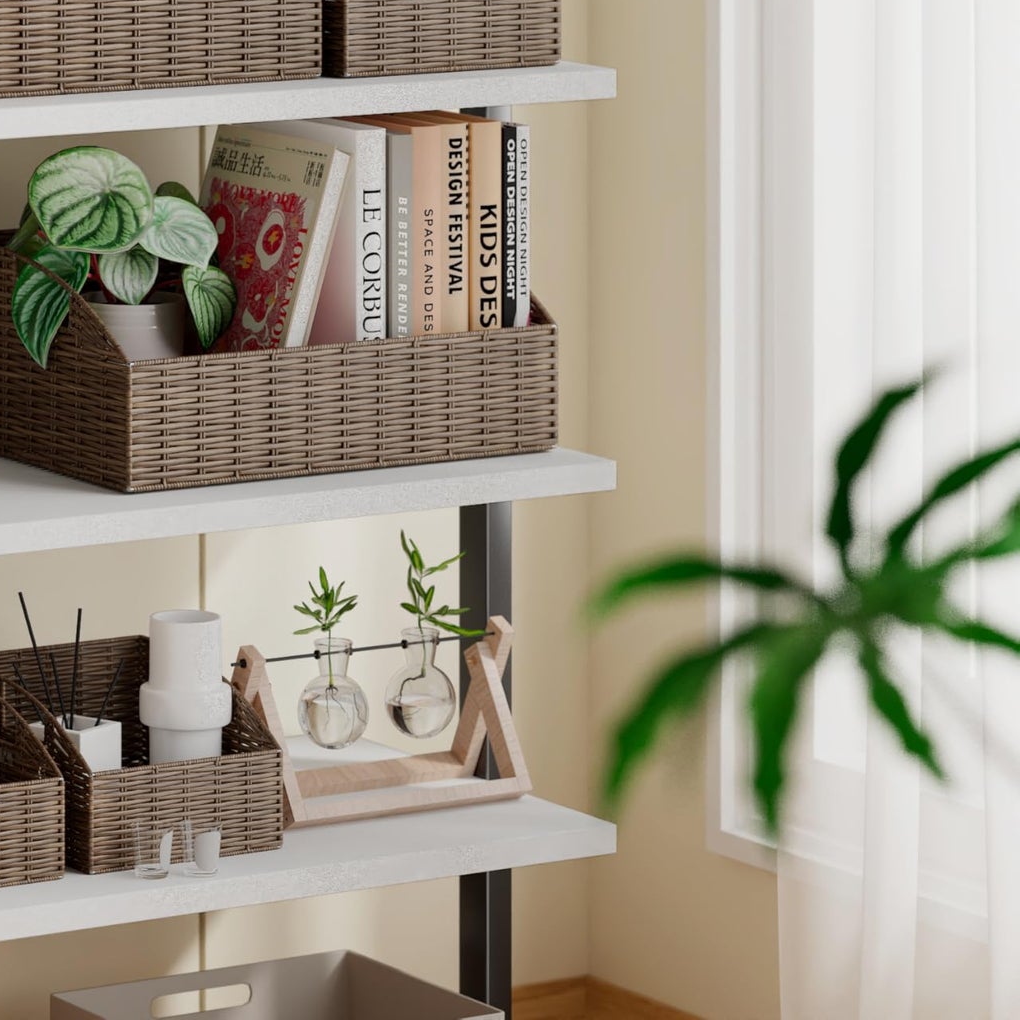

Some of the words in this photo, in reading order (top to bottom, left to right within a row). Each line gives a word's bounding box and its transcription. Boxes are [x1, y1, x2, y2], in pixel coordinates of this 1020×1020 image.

[448, 138, 463, 206] DESIGN
[507, 138, 516, 183] OPEN
[519, 138, 528, 181] OPEN
[362, 188, 382, 223] LE
[397, 196, 408, 214] BE
[506, 186, 515, 246] DESIGN
[519, 186, 528, 244] DESIGN
[397, 220, 408, 276] BETTER
[423, 208, 434, 257] SPACE
[448, 213, 463, 295] FESTIVAL
[479, 203, 498, 268] KIDS
[423, 263, 434, 296] AND
[506, 249, 515, 300] NIGHT
[519, 248, 528, 298] NIGHT
[397, 283, 408, 338] RENDE
[423, 303, 434, 332] DES
[479, 276, 498, 329] DES
